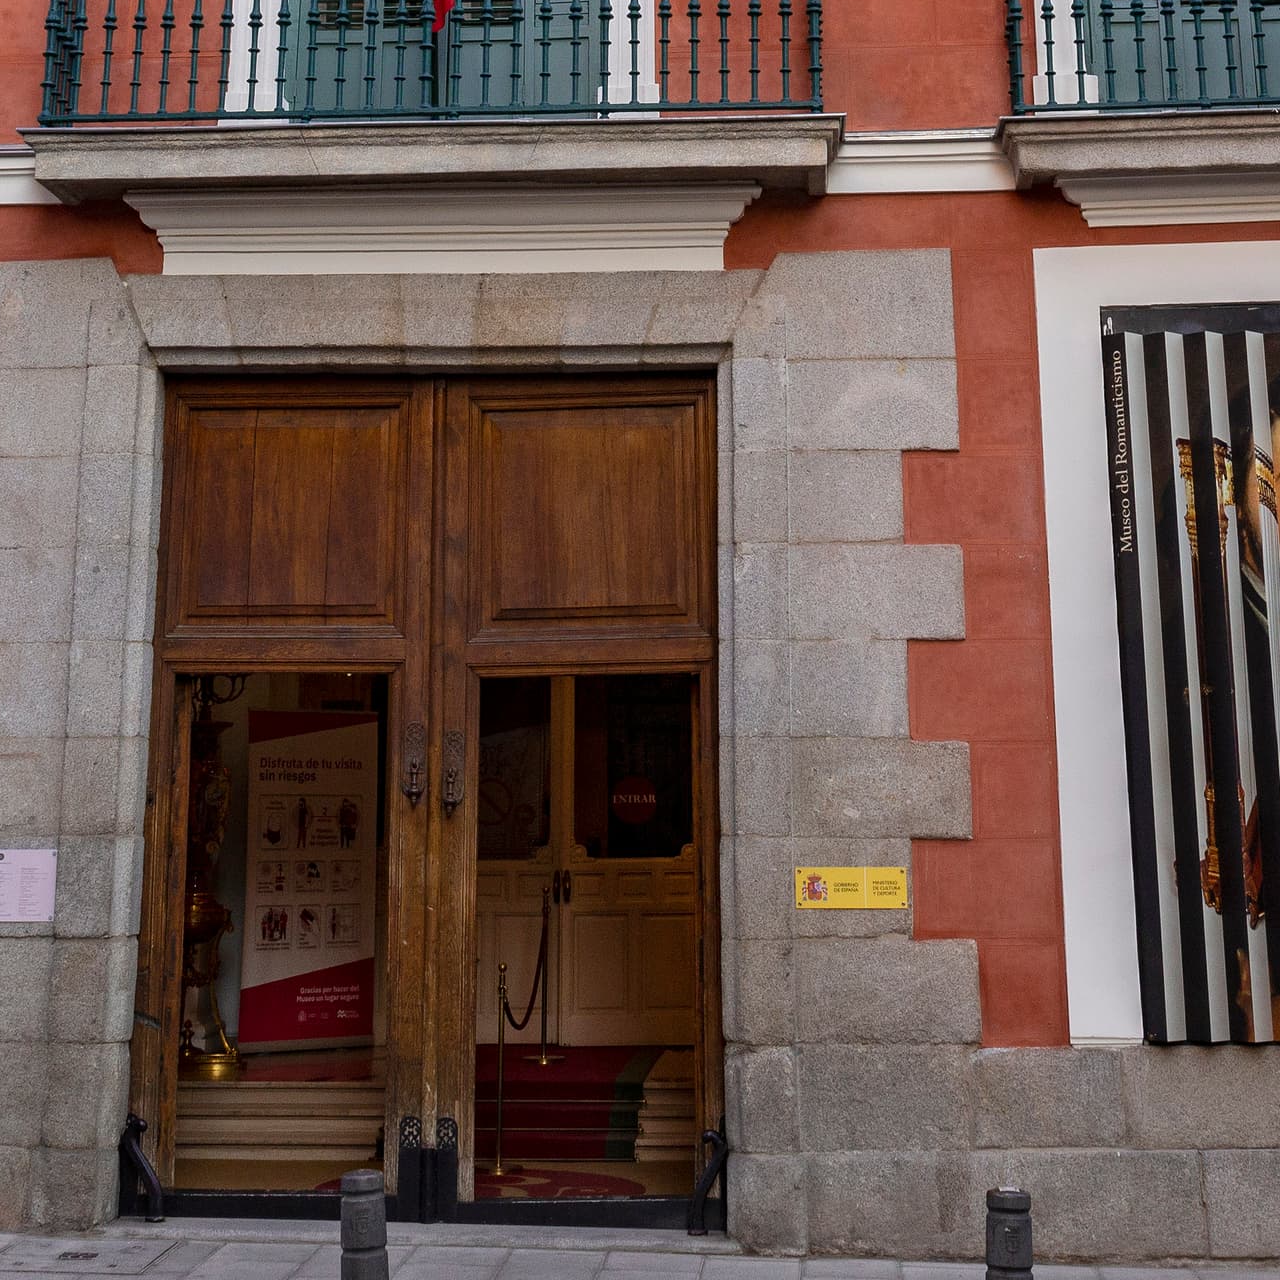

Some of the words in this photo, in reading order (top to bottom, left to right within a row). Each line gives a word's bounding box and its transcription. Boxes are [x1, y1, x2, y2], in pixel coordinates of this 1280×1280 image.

[1111, 350, 1128, 466] Romanticismo
[1115, 469, 1129, 495] del
[1121, 497, 1133, 553] Museo
[260, 757, 303, 769] Disfruta
[306, 757, 319, 769] de
[322, 759, 331, 769] tu
[335, 758, 362, 770] visita
[259, 770, 275, 781] sin
[278, 770, 317, 784] riesgos
[613, 793, 656, 805] ENTRAR
[299, 986, 322, 994] Gracias
[322, 986, 333, 995] por
[333, 985, 349, 993] hacer
[350, 984, 360, 993] del
[296, 995, 315, 1003] Museo
[324, 994, 340, 1003] lugar
